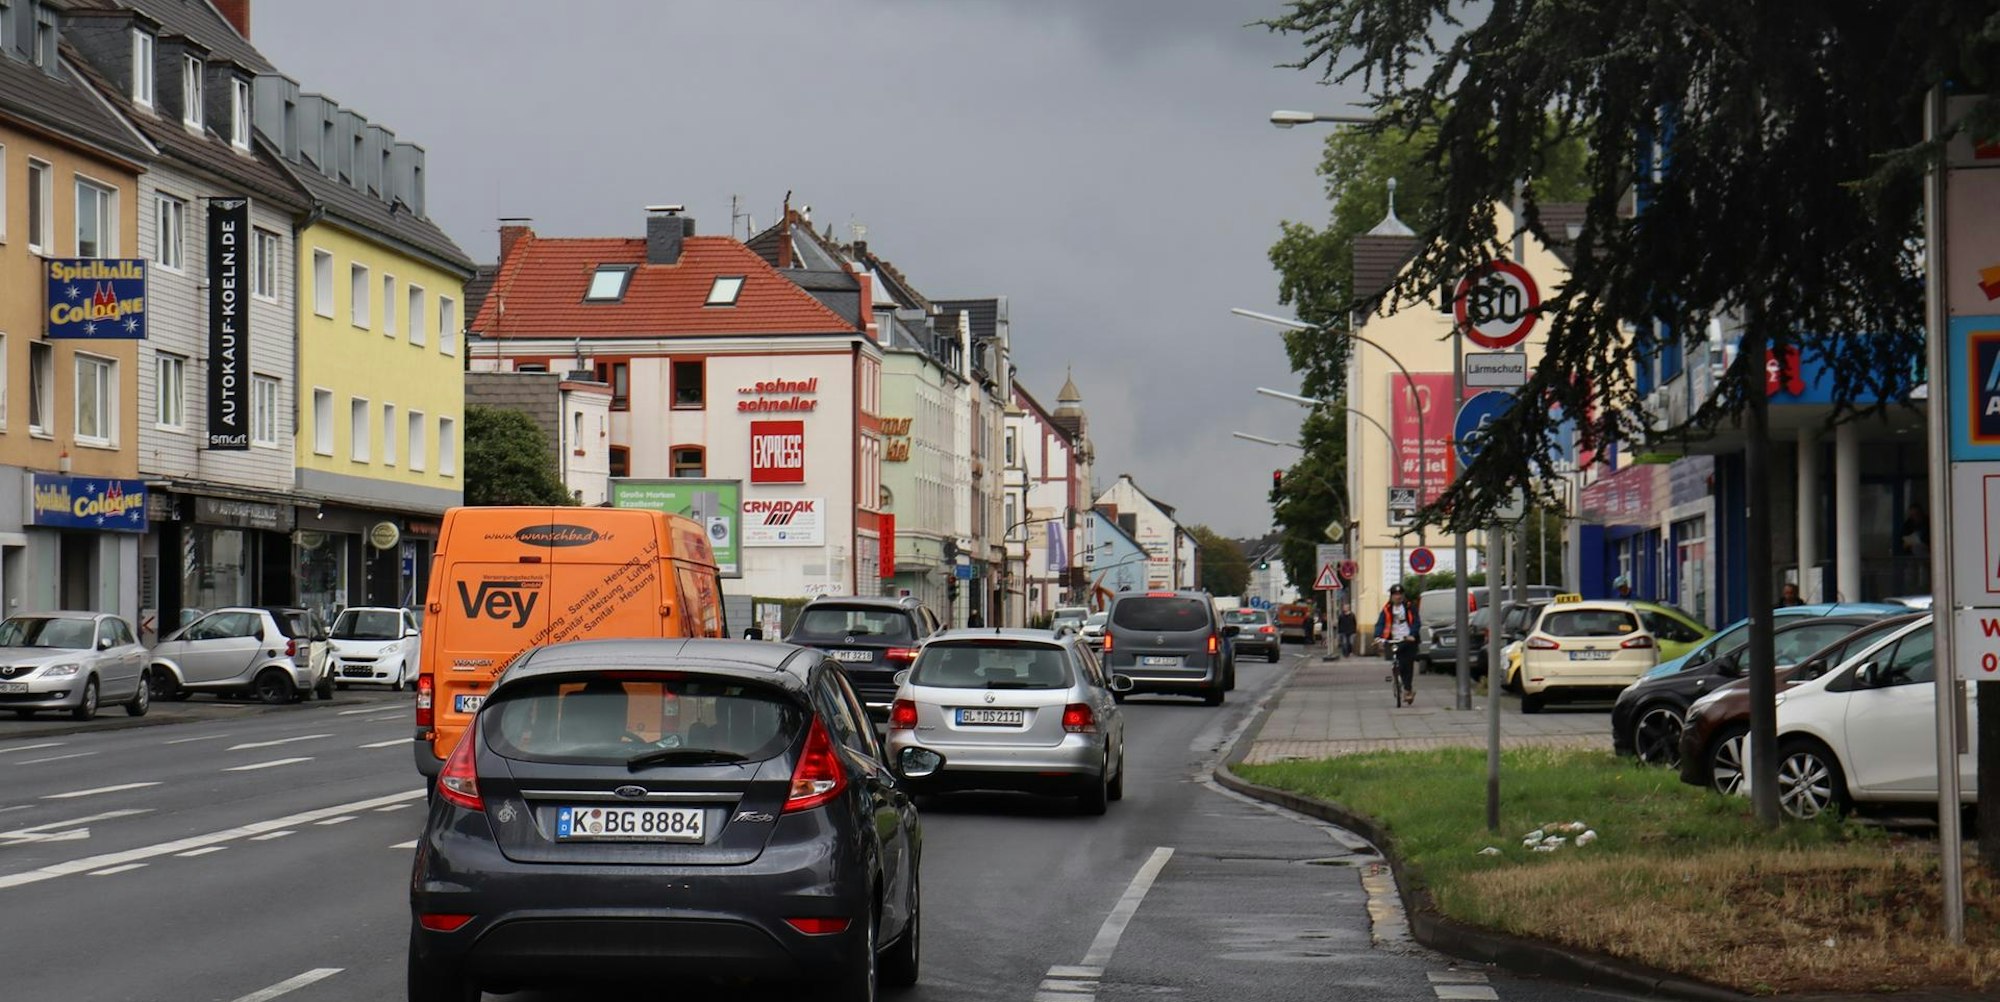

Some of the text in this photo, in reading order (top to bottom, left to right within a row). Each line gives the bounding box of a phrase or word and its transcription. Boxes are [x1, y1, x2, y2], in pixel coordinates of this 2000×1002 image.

[222, 220, 236, 426] AUTOKAUF-KOELN.DE
[1468, 364, 1523, 375] Lärmschutz
[737, 397, 818, 412] schneller
[210, 434, 247, 445] smart
[753, 435, 802, 469] EXPRESS
[742, 500, 815, 521] CRNADAK
[484, 528, 615, 542] www.wunschbad.de
[883, 515, 893, 574] TATTOO
[457, 580, 542, 629] Vey
[530, 616, 565, 647] Lüftung
[568, 586, 600, 616] Sanitär
[603, 556, 641, 586] Heizung
[553, 615, 584, 642] Sanitär
[588, 583, 625, 613] Heizung
[627, 555, 660, 583] Lüftung
[583, 573, 655, 632] Sanitär Heizung
[463, 698, 471, 709] K
[963, 710, 1021, 723] GL DS 2111
[573, 811, 700, 833] K BG 8884
